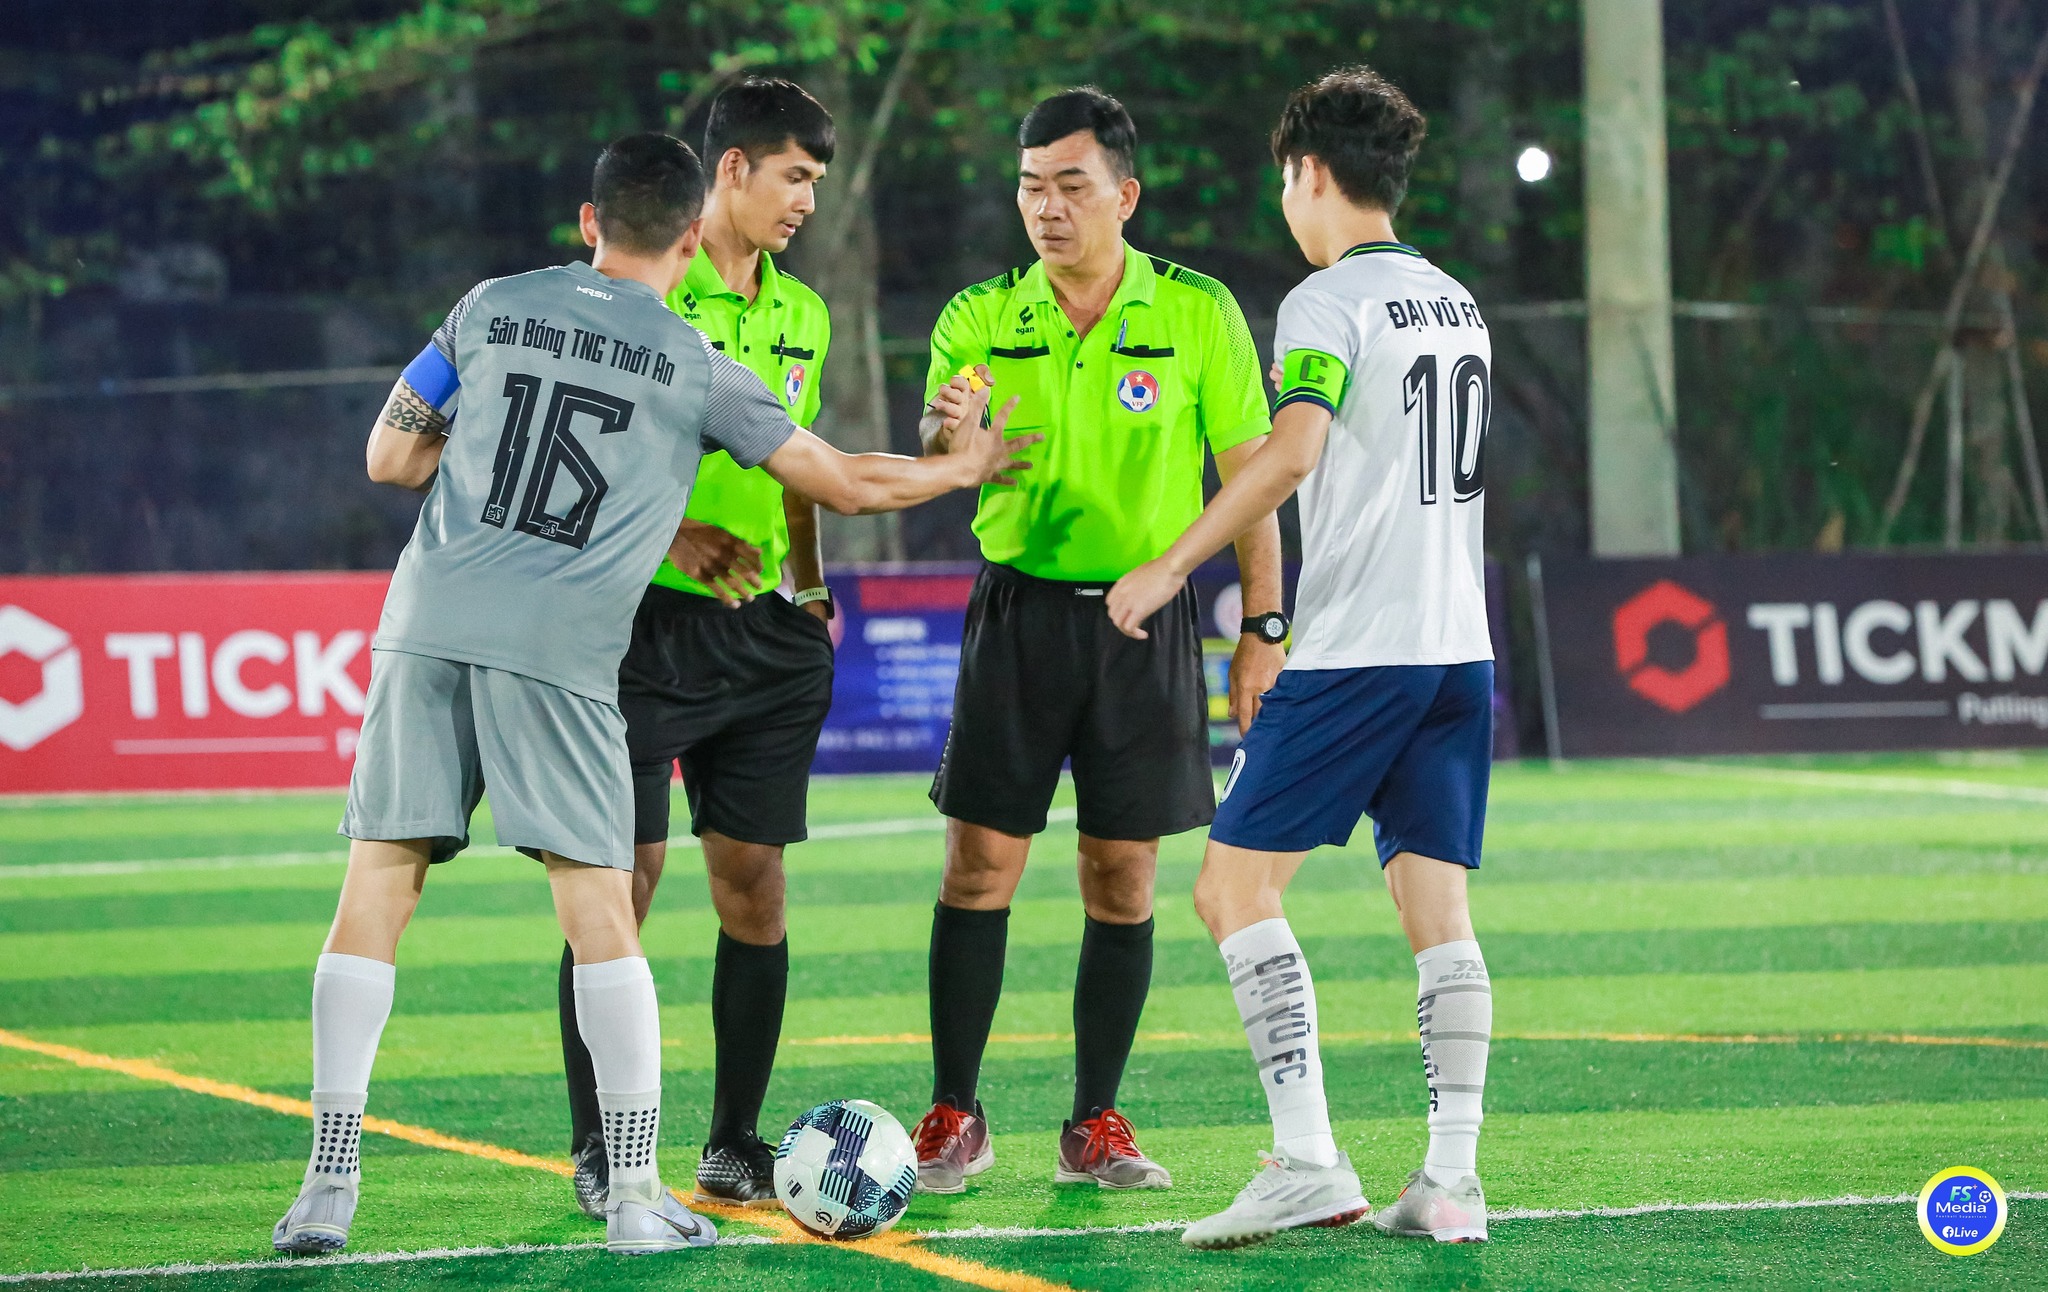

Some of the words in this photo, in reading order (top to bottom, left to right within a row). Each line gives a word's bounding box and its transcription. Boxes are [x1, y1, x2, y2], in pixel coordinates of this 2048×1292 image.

[1015, 326, 1035, 335] egan
[1385, 299, 1429, 332] ĐẠI
[1427, 296, 1460, 327] VŨ
[1460, 302, 1484, 329] FC
[487, 315, 518, 344] Sân
[521, 318, 566, 359] Bóng
[570, 328, 609, 364] TNG
[652, 352, 676, 386] An
[1299, 354, 1328, 384] C
[1403, 355, 1491, 505] 10
[480, 372, 635, 550] 16
[104, 629, 376, 719] TICK
[1271, 1048, 1307, 1085] FC
